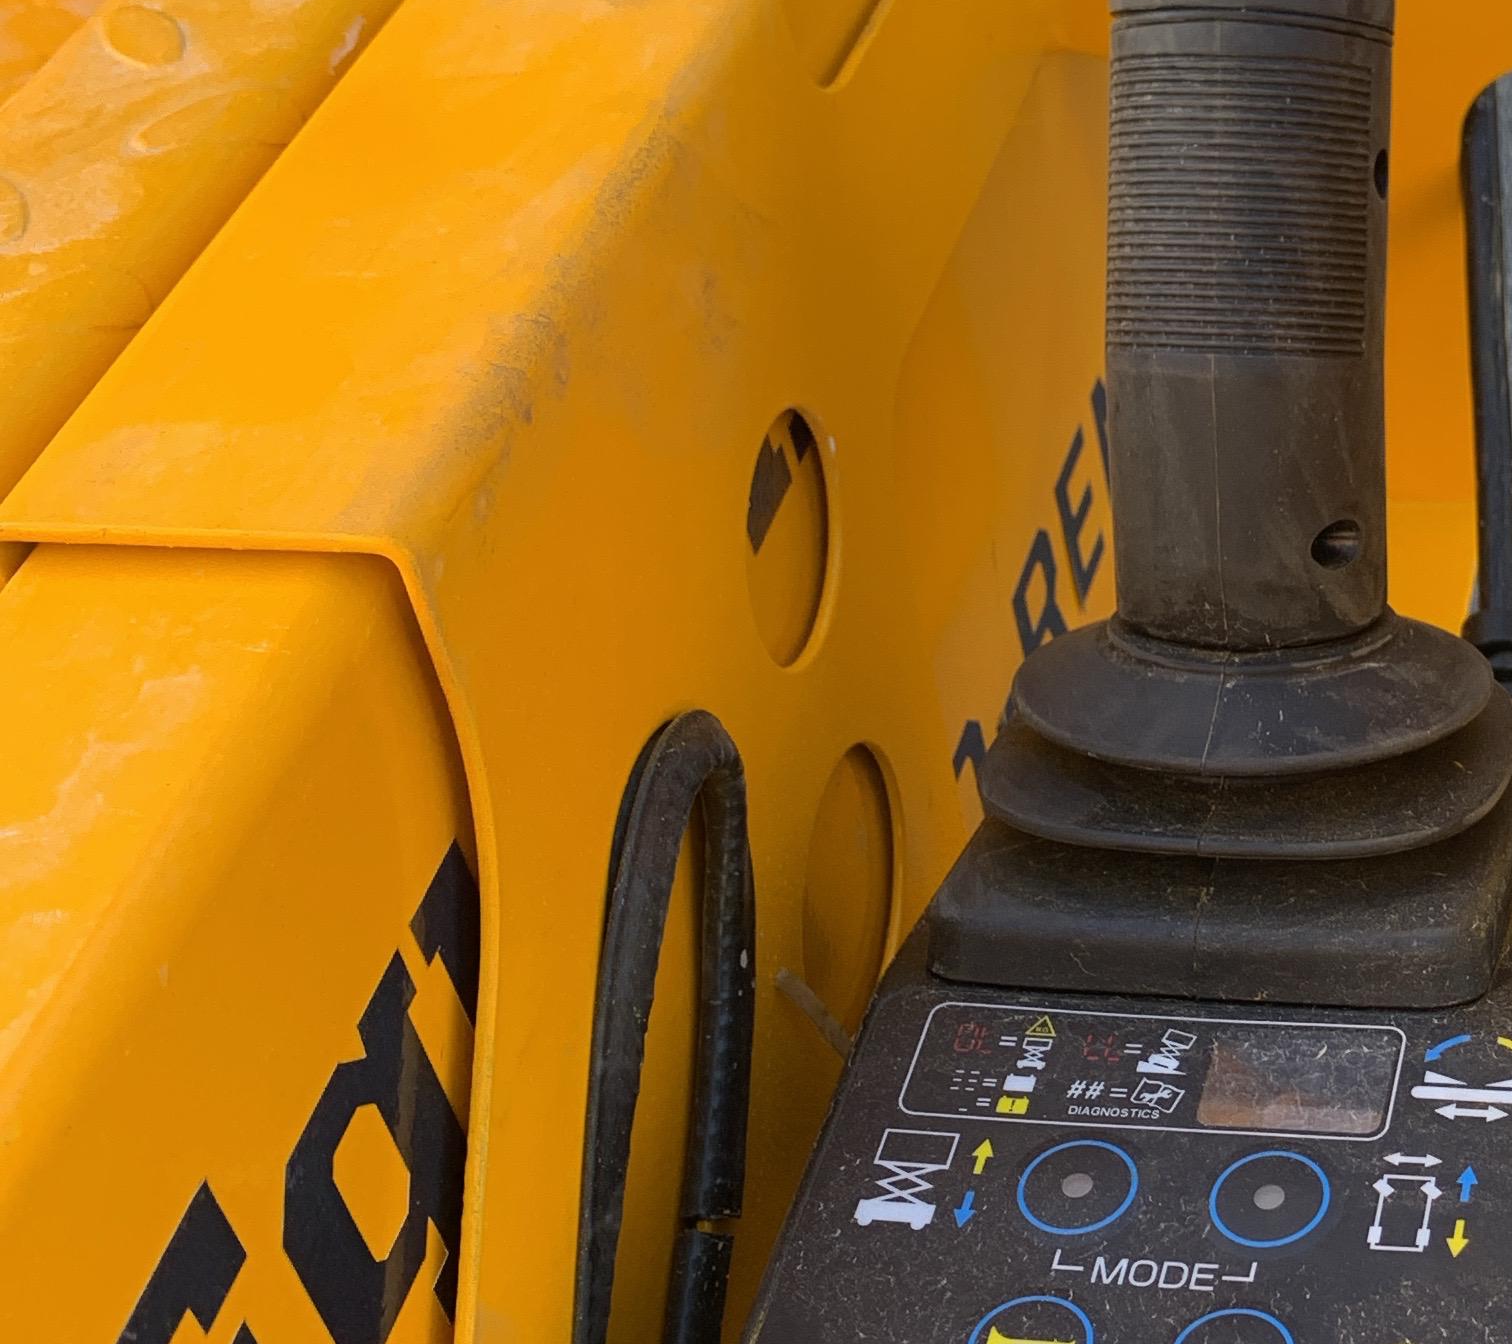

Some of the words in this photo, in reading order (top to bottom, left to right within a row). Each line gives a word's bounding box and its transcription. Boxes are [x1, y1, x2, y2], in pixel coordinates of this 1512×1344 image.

[1012, 376, 1113, 658] RE
[1067, 1104, 1160, 1120] DIAGNOSTICS
[1090, 1256, 1220, 1292] MODE
